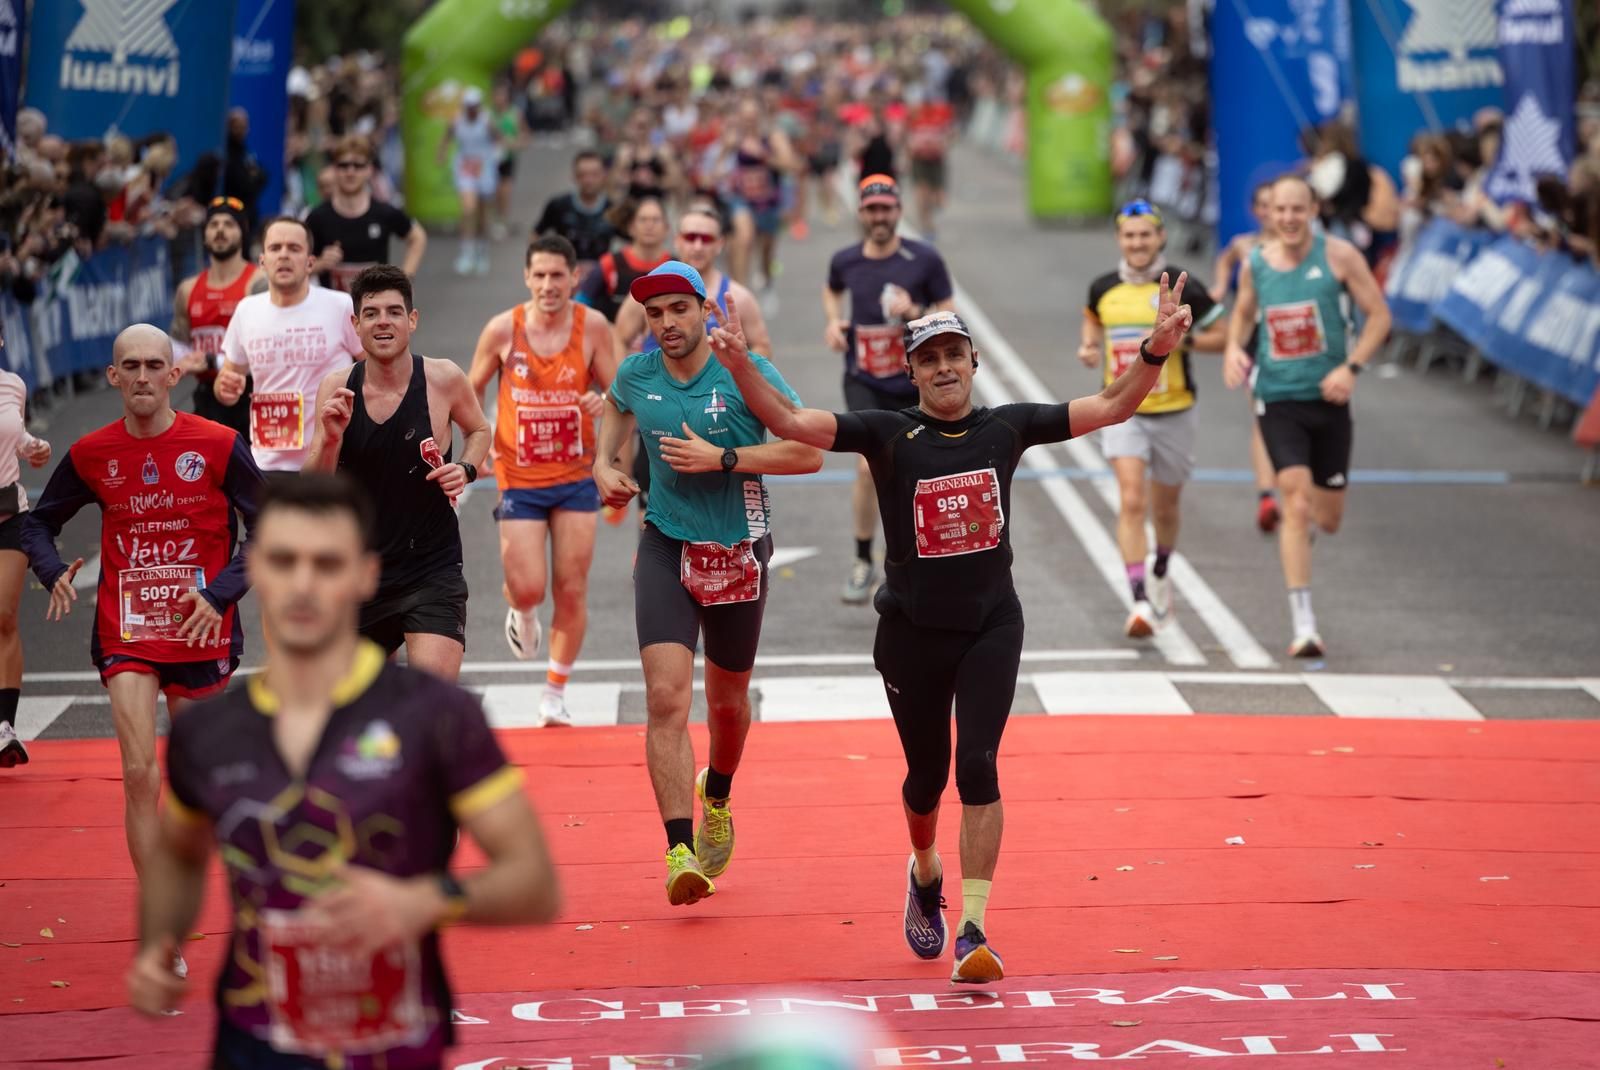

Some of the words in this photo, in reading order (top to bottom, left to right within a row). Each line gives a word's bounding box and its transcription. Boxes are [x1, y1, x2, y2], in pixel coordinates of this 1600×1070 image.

[60, 53, 181, 97] luanvi
[261, 405, 288, 418] 3149
[932, 474, 984, 493] GENERALI
[177, 495, 207, 505] DENTAL
[937, 494, 969, 513] 959
[129, 518, 189, 534] ATLETISMO
[141, 568, 192, 580] GENERALI
[140, 585, 180, 601] 5097
[511, 983, 1416, 1022] GENERALI
[454, 1034, 1407, 1070] GEERALI
